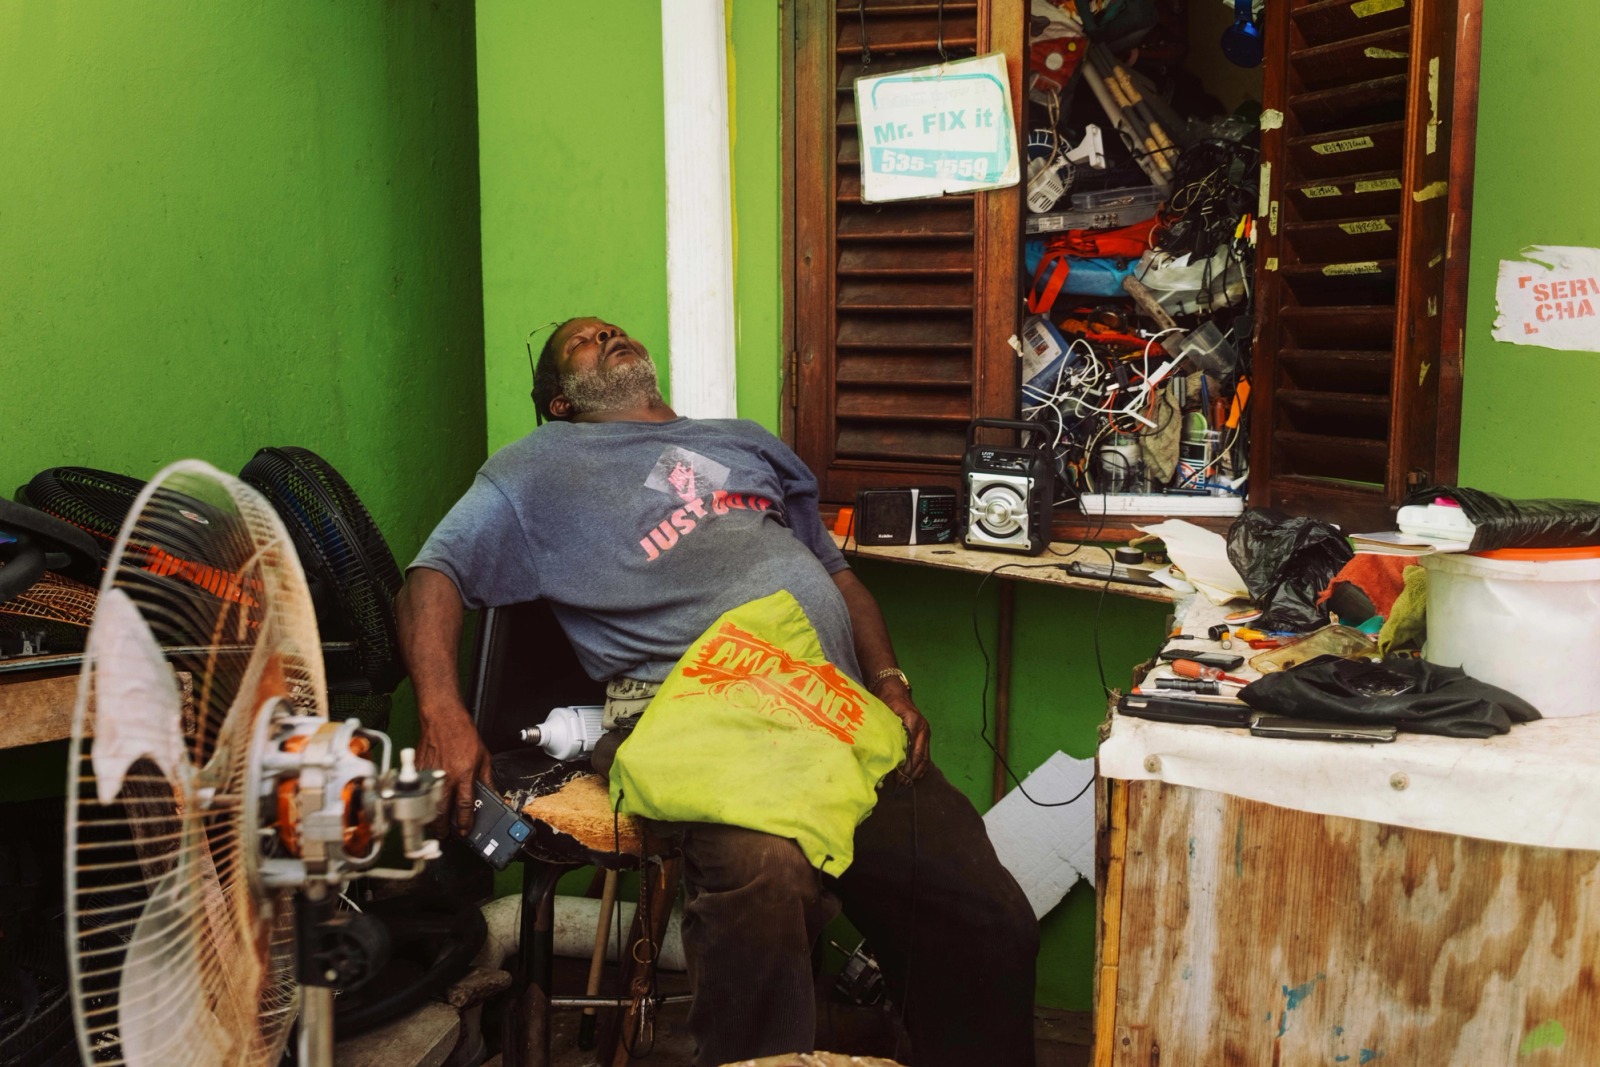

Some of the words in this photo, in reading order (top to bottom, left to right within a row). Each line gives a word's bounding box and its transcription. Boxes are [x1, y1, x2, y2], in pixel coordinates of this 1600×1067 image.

[873, 122, 913, 145] Mr.
[922, 109, 966, 135] FIX
[975, 108, 993, 128] it
[881, 150, 988, 181] 535-1559
[1536, 299, 1595, 323] CHA
[639, 498, 708, 562] JUST
[708, 641, 853, 730] AMAZING
